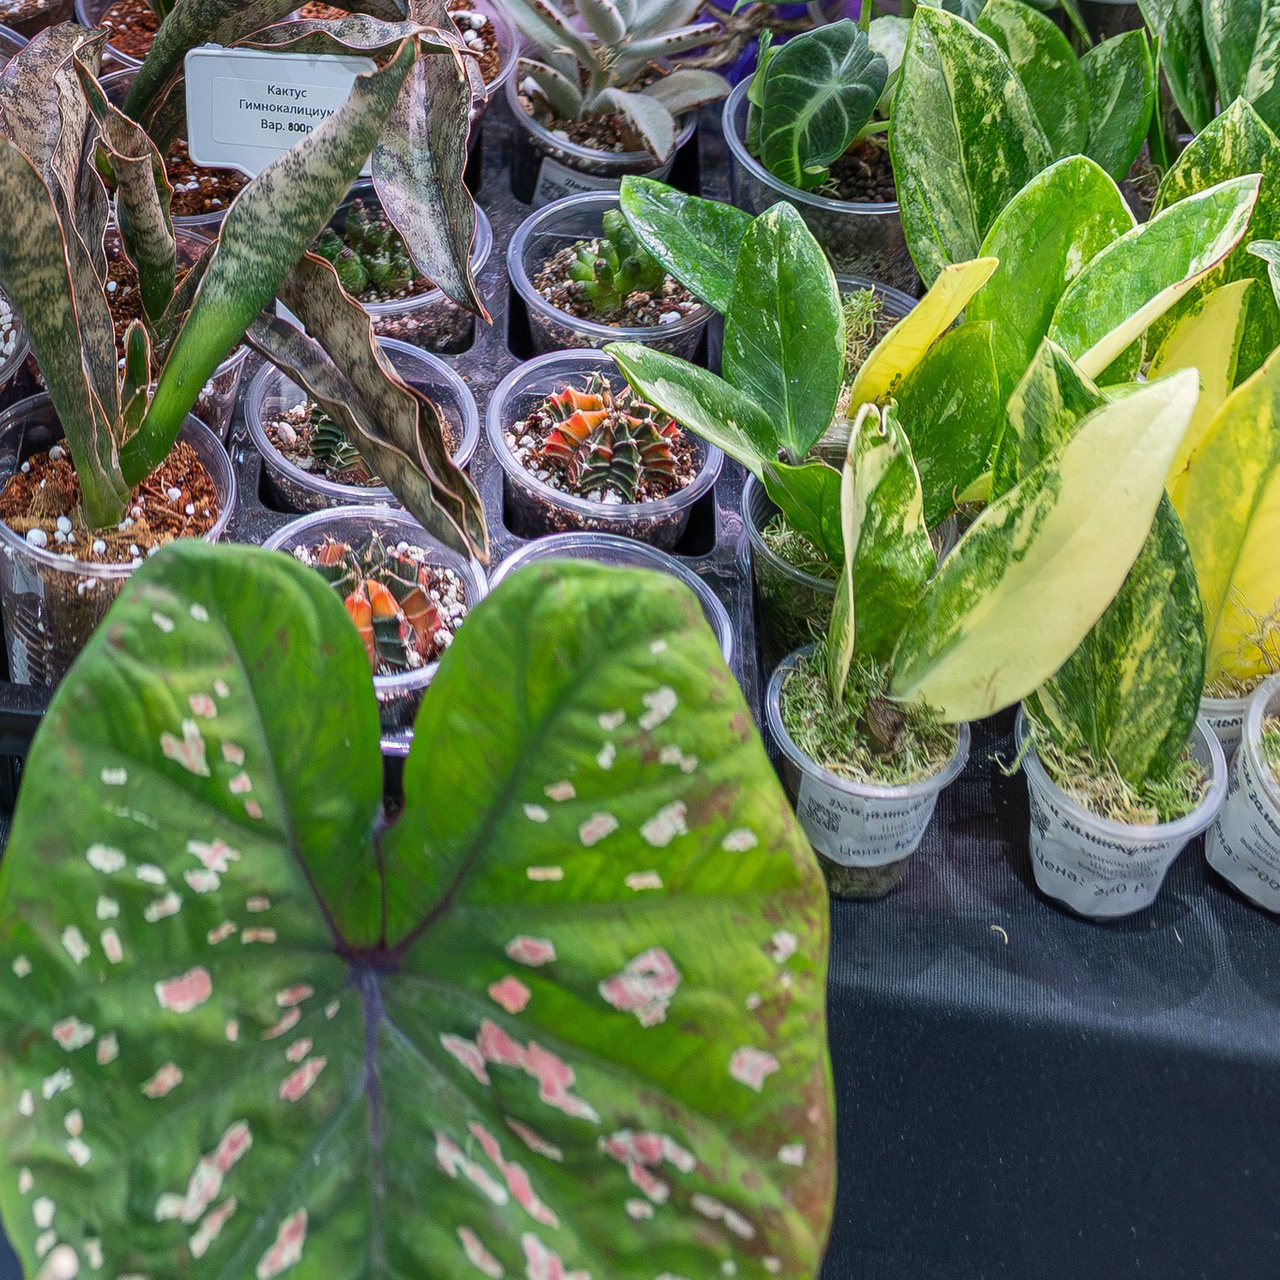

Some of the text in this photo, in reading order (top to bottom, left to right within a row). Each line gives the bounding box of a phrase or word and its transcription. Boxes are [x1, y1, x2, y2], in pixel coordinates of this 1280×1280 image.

[267, 85, 308, 99] Кактус
[239, 99, 335, 119] Гимнокалициум
[261, 119, 286, 133] Вар.
